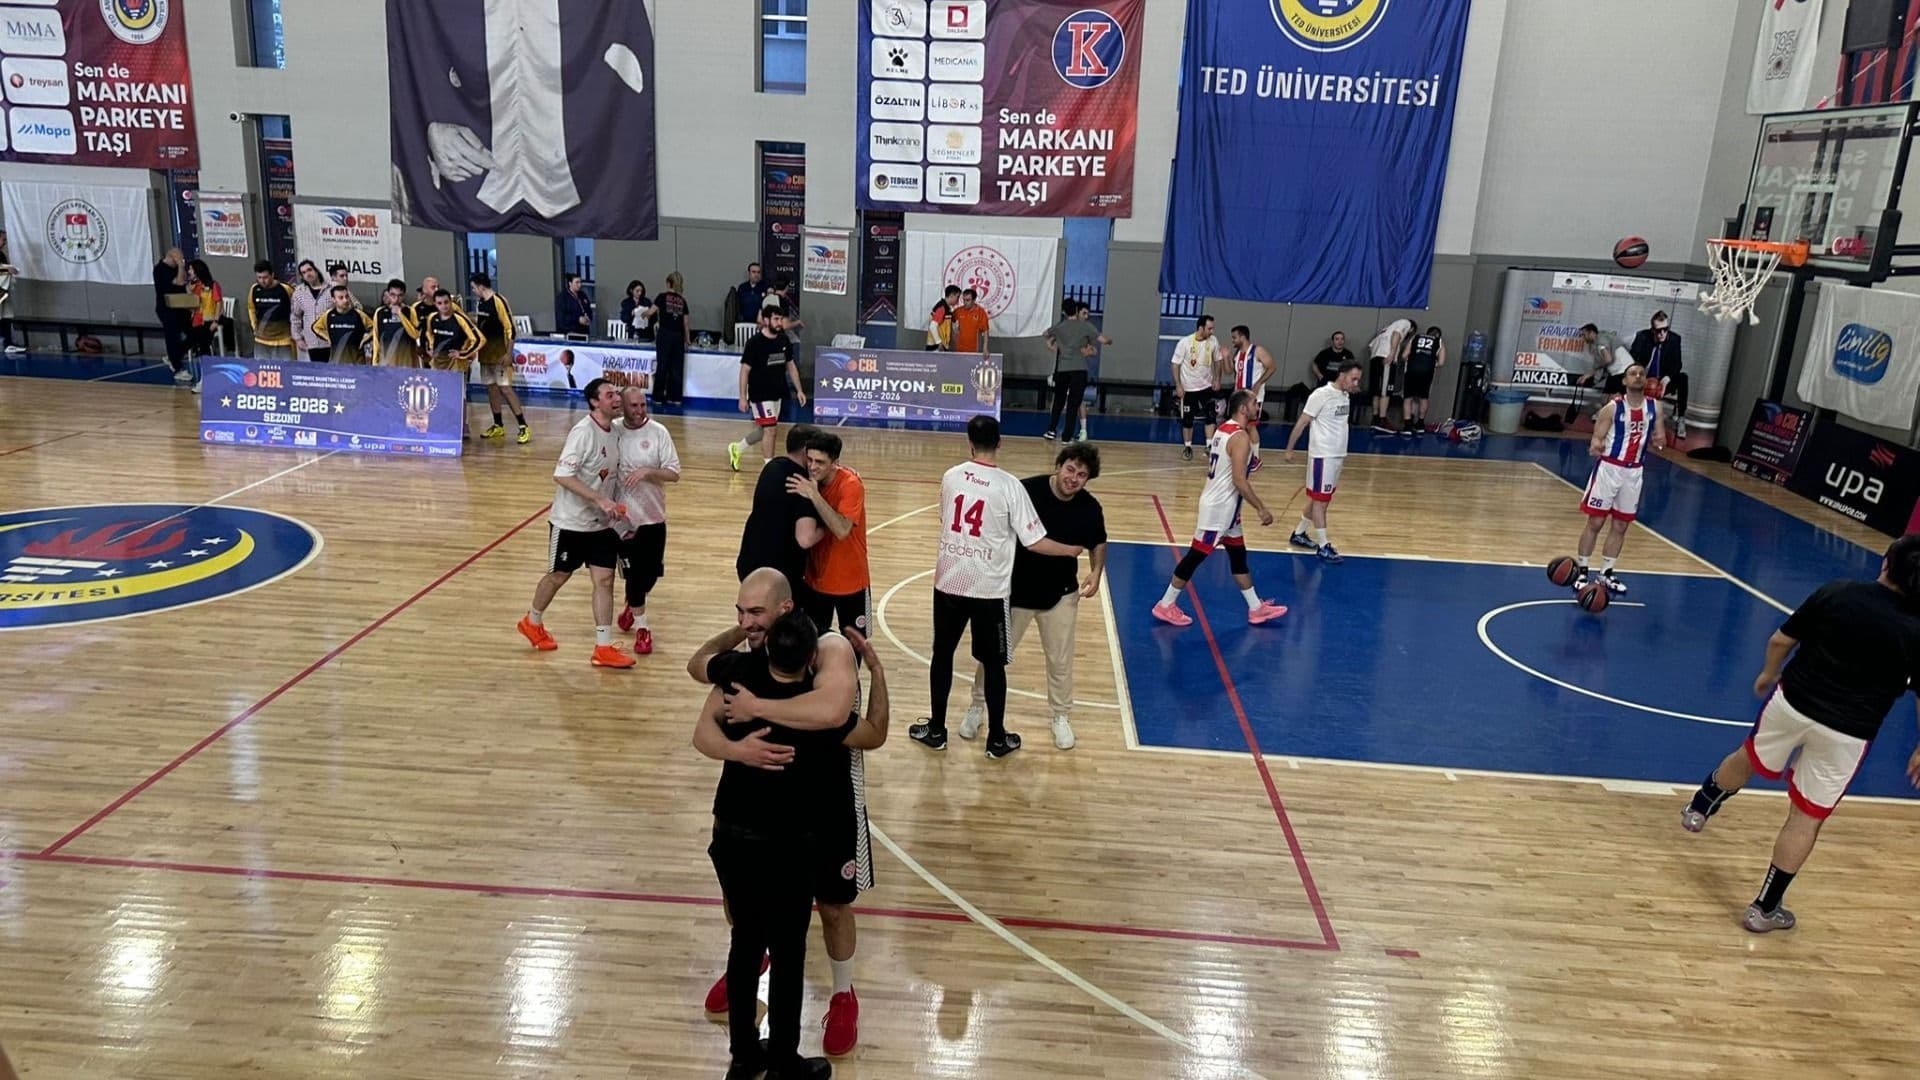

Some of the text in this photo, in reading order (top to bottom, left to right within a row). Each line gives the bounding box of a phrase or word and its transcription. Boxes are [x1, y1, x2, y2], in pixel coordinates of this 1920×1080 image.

[1291, 13, 1306, 28] TED
[1065, 22, 1110, 77] K
[74, 62, 130, 79] Sen de
[29, 76, 64, 88] treysan
[1201, 65, 1440, 107] TED ÜNİVERSİTESİ
[76, 81, 187, 105] MARKANI
[874, 94, 920, 107] ÖZALTIN
[79, 106, 185, 130] PARKEYE
[999, 108, 1056, 125] Sen de
[33, 124, 71, 138] Mapa
[83, 132, 132, 157] TAŞI
[999, 129, 1114, 151] MARKANI
[998, 156, 1106, 177] PARKEYE
[996, 181, 1048, 207] TAŞI
[357, 214, 379, 229] CBL
[321, 227, 379, 238] WE ARE FAMILY
[602, 356, 648, 371] KRAVATINI
[858, 358, 879, 373] CBL
[1515, 353, 1540, 367] CBL
[258, 370, 284, 389] CBL
[832, 376, 926, 393] ŞAMPİYON
[1512, 371, 1569, 385] ANKARA
[236, 394, 277, 411] 2025
[289, 397, 329, 414] 2026
[405, 384, 430, 411] 10
[853, 391, 873, 399] 2025
[880, 392, 901, 401] 2026
[263, 412, 301, 424] SEZONU
[1630, 422, 1643, 433] 26
[364, 442, 385, 450] upa
[1825, 462, 1884, 504] upa
[1589, 497, 1602, 507] 26
[951, 494, 985, 538] 14
